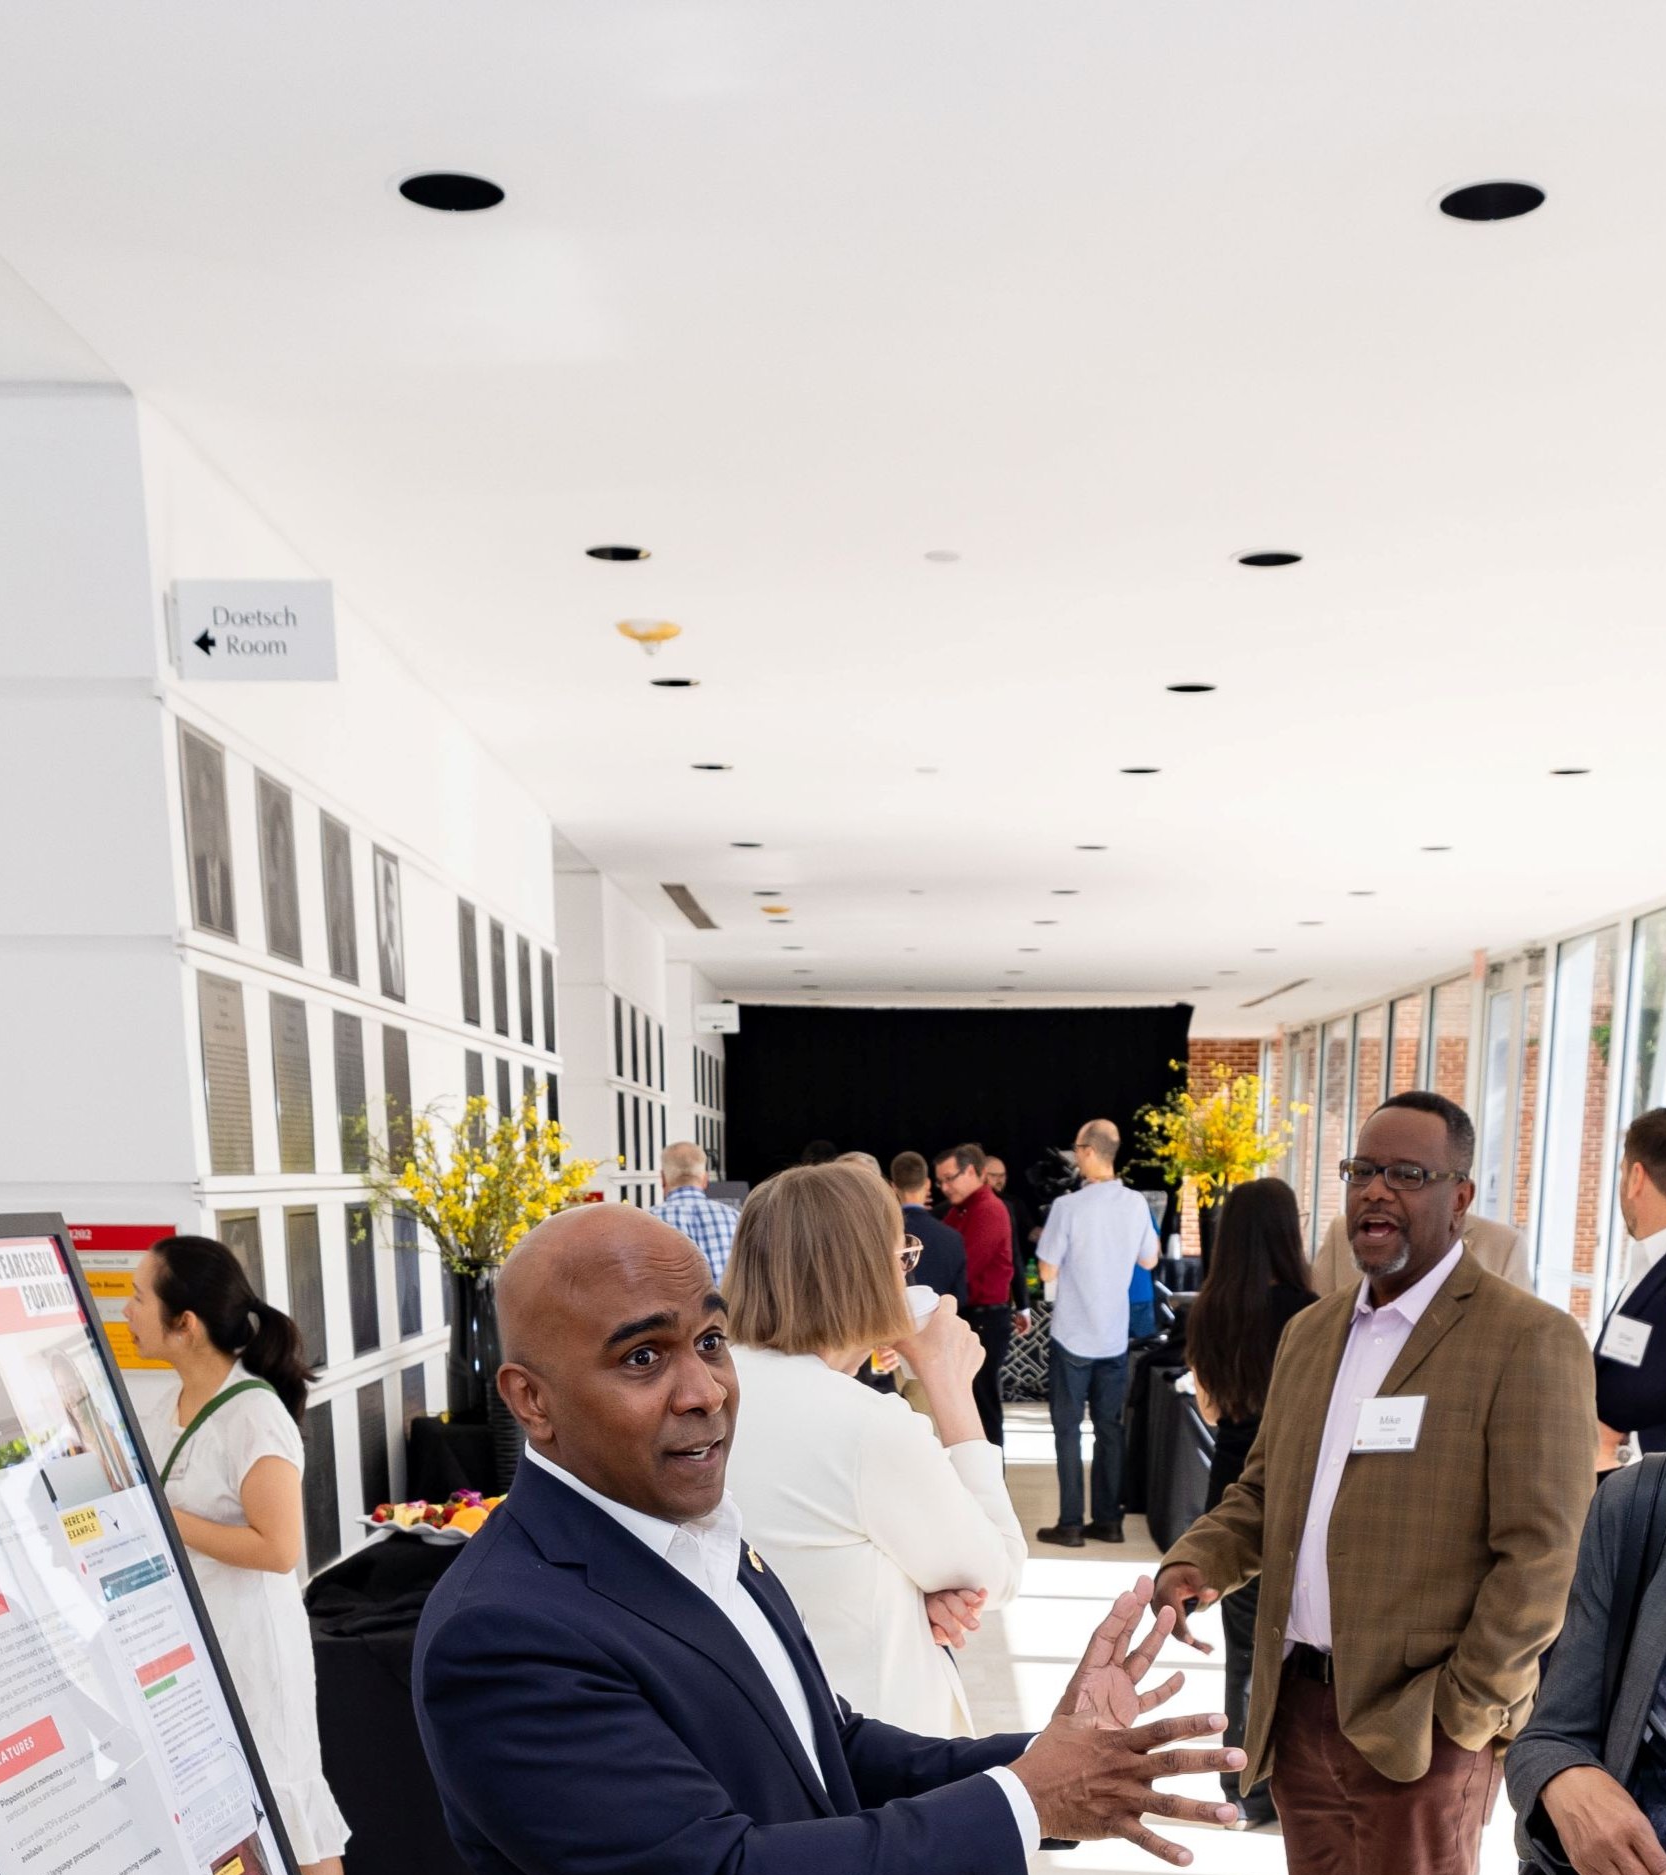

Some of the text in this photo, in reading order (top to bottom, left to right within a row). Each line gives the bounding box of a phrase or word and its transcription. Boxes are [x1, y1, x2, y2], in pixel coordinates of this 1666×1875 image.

[213, 605, 298, 628] Doetsch
[226, 634, 288, 656] Room
[22, 1281, 75, 1310] FORWARD
[1379, 1416, 1401, 1425] Mike
[63, 1510, 97, 1528] HERE'S AN
[67, 1524, 97, 1540] EXAMPLE
[38, 1769, 63, 1791] moments
[73, 1841, 101, 1864] processing
